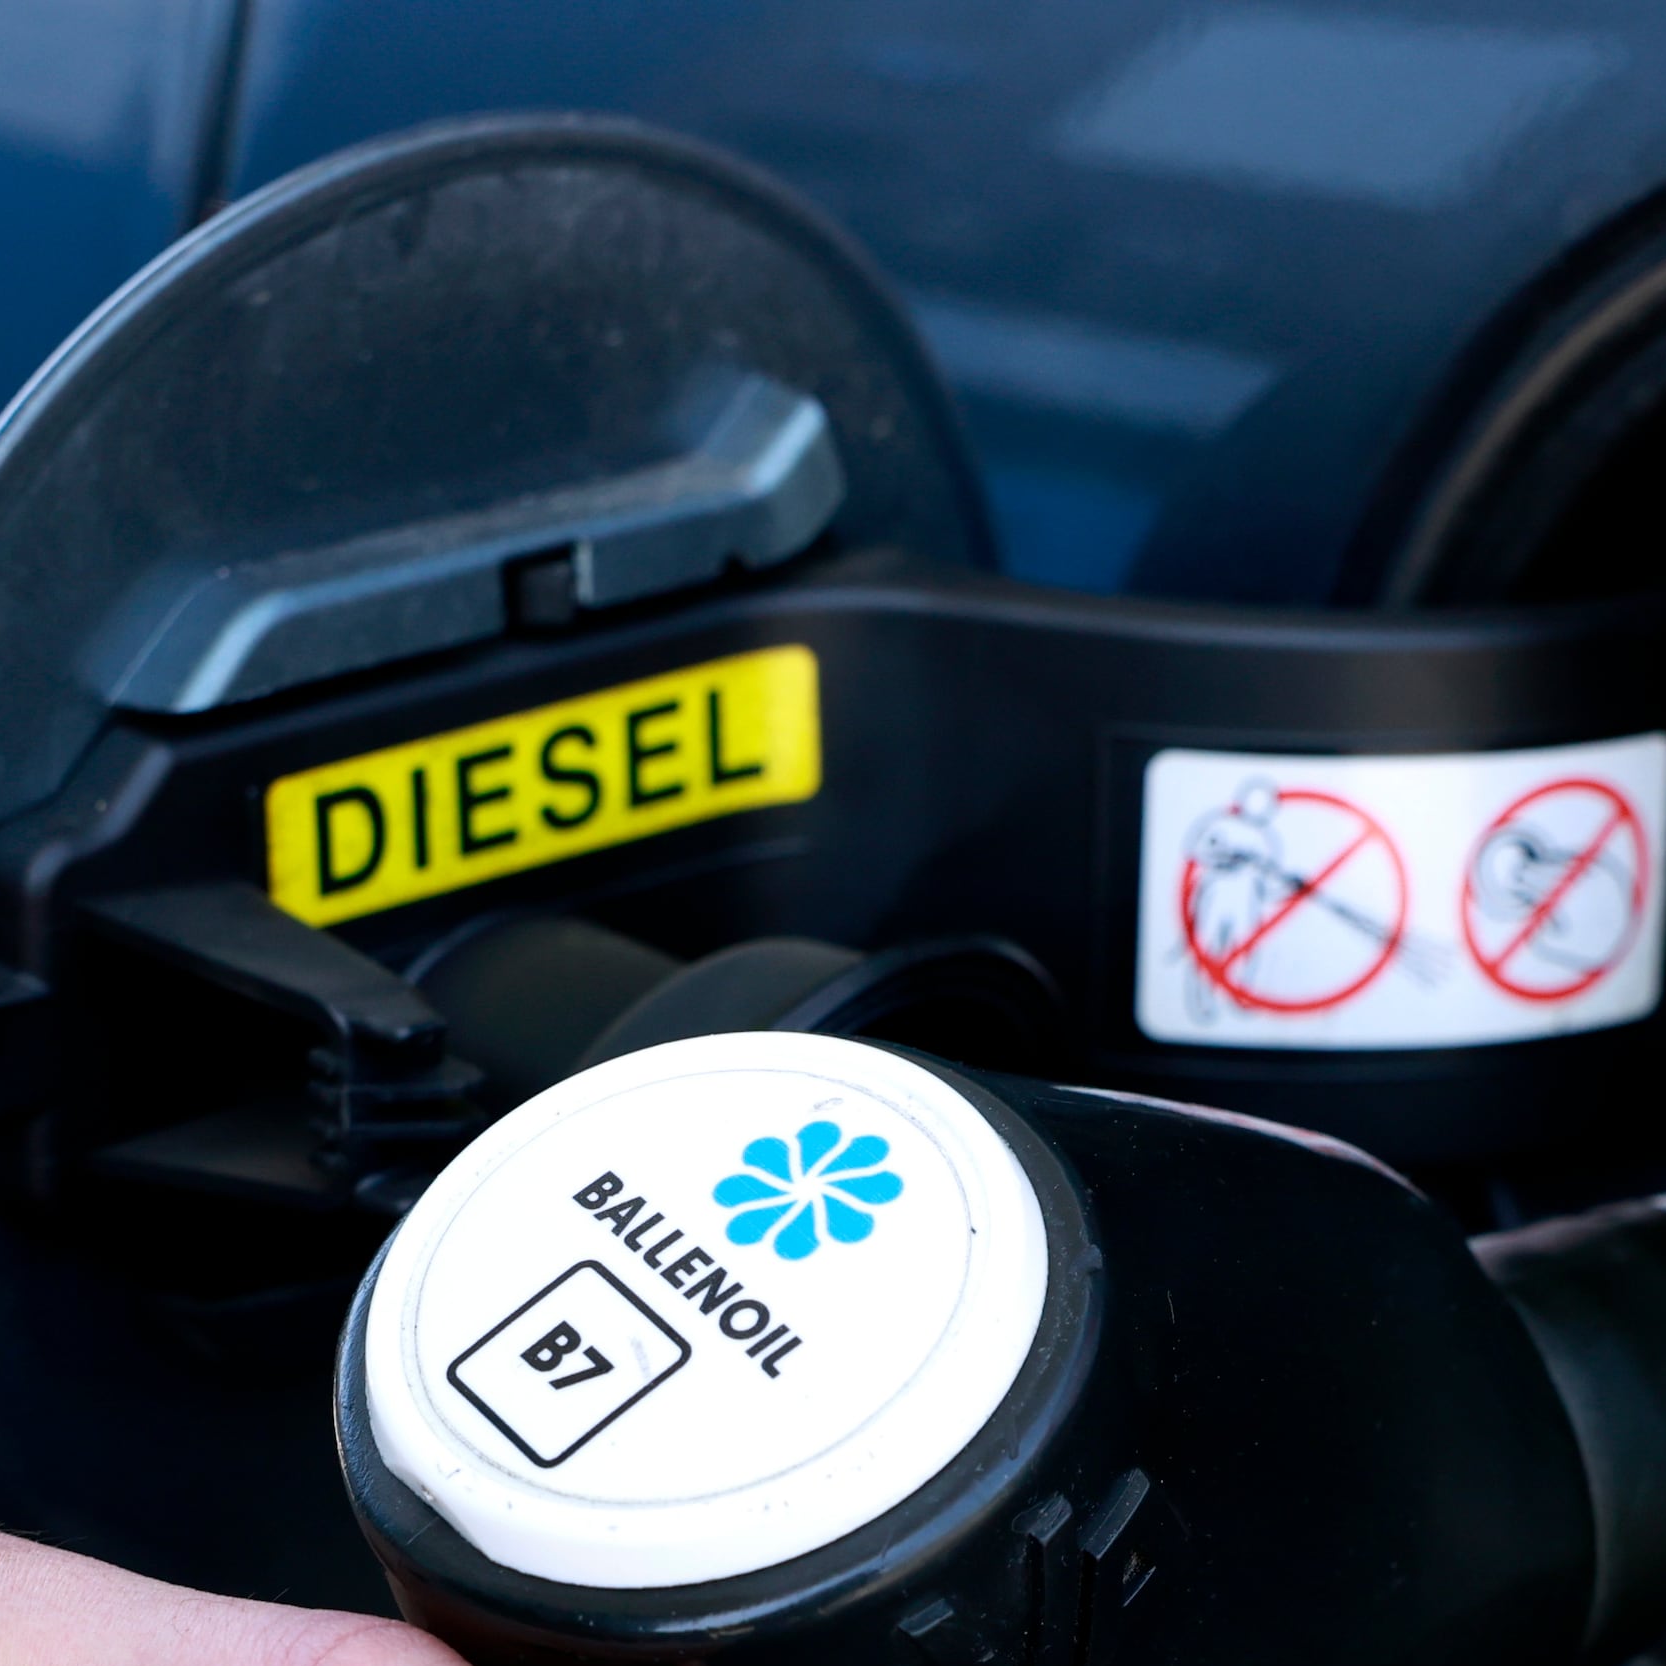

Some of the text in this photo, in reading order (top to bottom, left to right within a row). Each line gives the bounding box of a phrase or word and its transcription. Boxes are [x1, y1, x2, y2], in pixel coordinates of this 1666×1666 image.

[314, 688, 765, 898] DIESEL
[520, 1320, 615, 1390] B7
[572, 1170, 803, 1379] BALLENOIL
